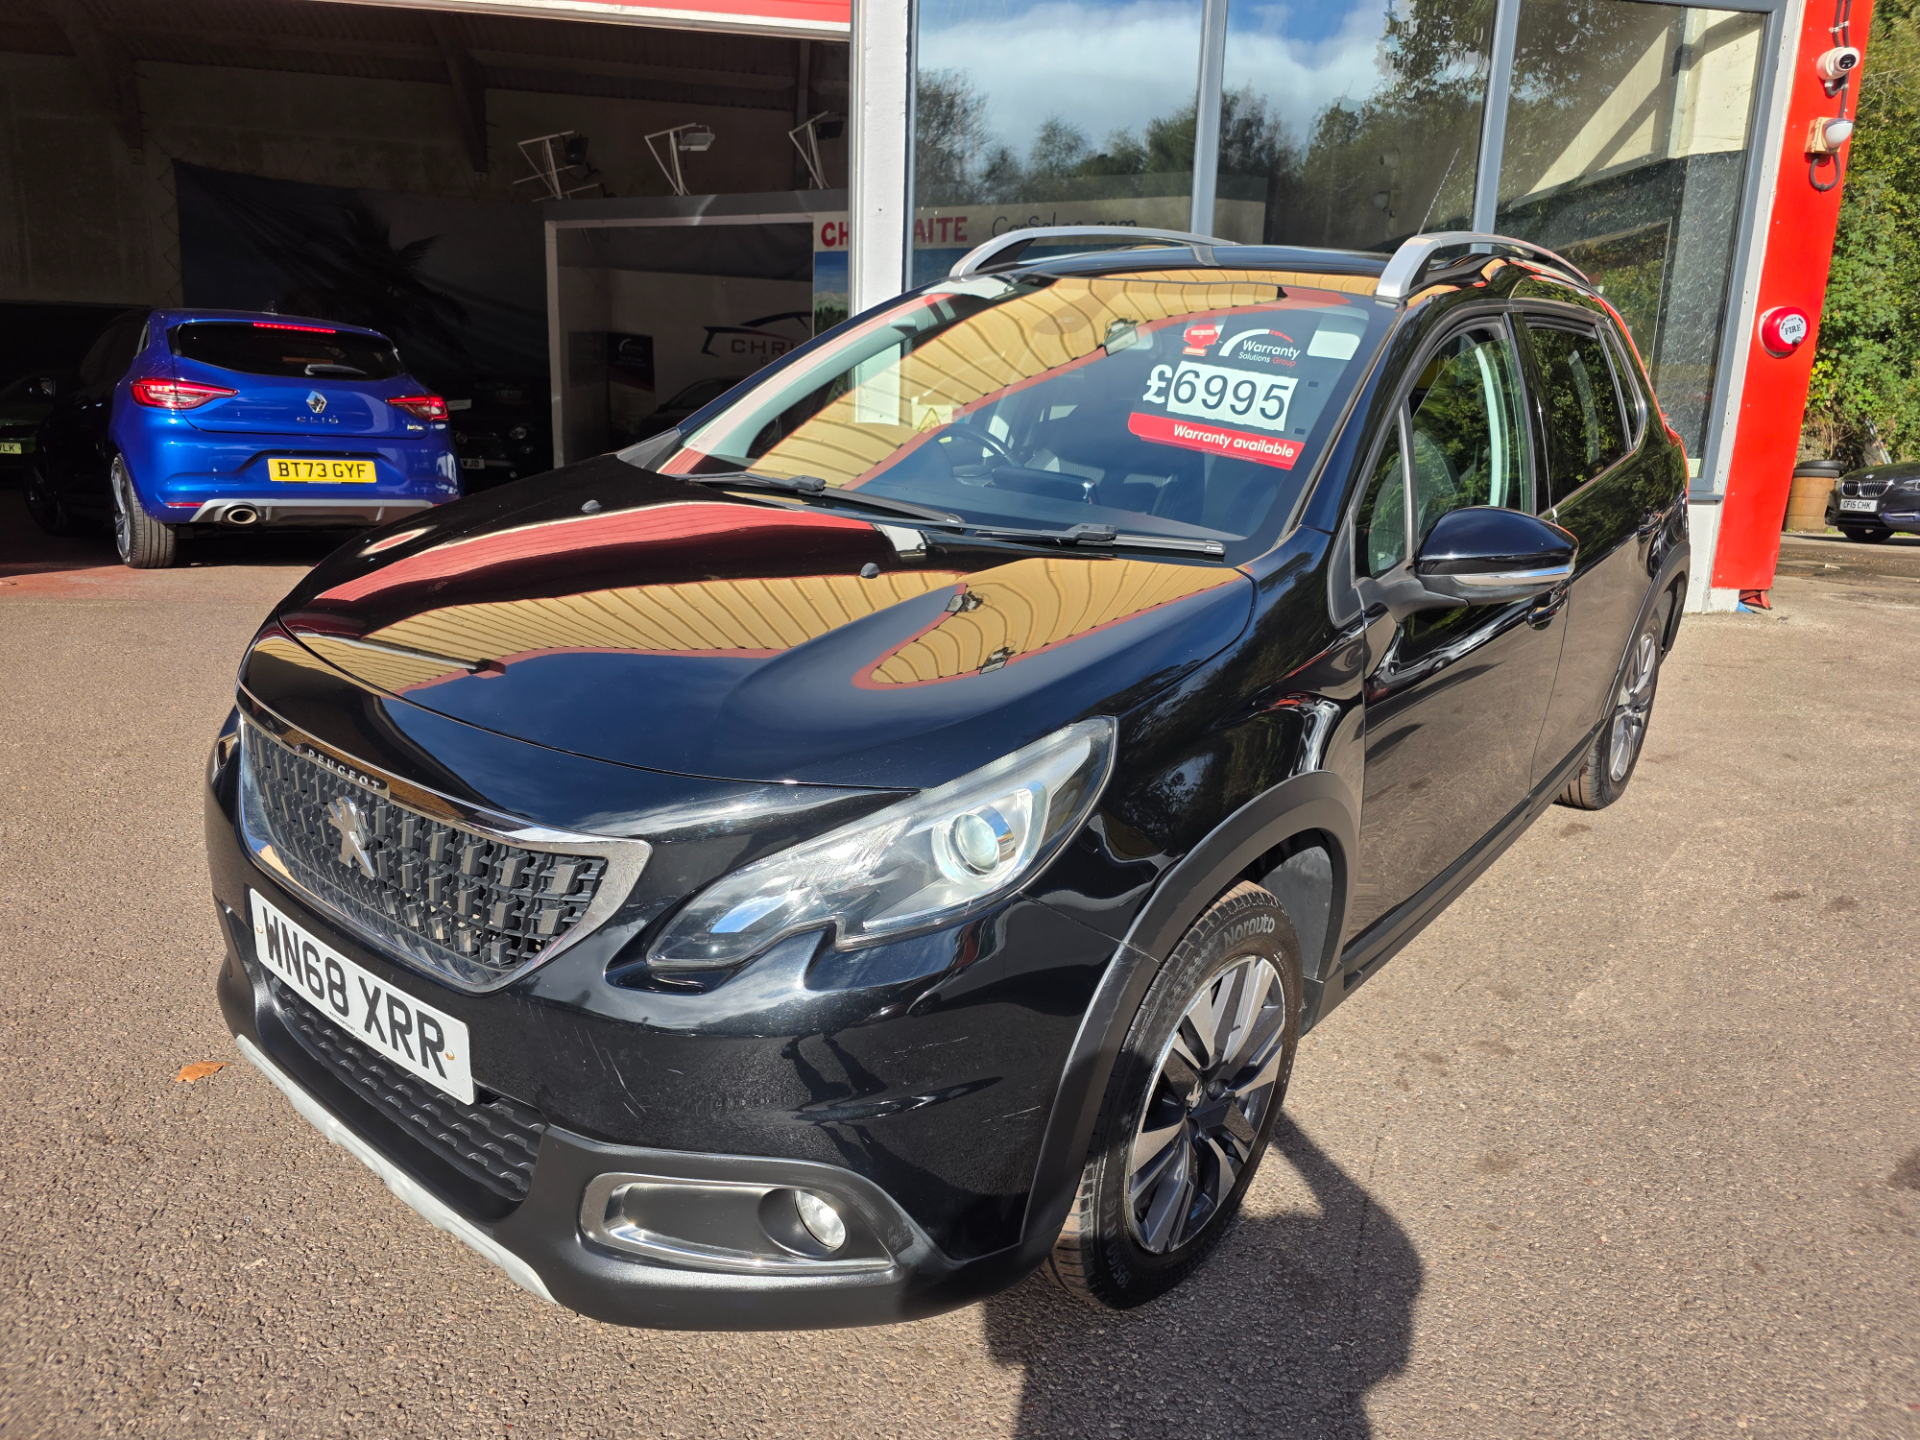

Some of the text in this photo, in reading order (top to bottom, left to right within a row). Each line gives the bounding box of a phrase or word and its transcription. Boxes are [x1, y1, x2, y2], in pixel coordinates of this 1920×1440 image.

[1785, 324, 1802, 335] FIRE
[1238, 351, 1296, 368] Solutions Group
[1243, 340, 1300, 360] Warranty
[1143, 364, 1289, 421] £6995
[0, 444, 15, 452] LK
[1174, 424, 1232, 449] Warranty
[1233, 438, 1294, 457] available
[278, 462, 366, 478] BT73 GYF
[308, 749, 379, 790] PEUGEOT
[1223, 914, 1275, 950] Norauto
[263, 906, 448, 1080] WN68 XRR
